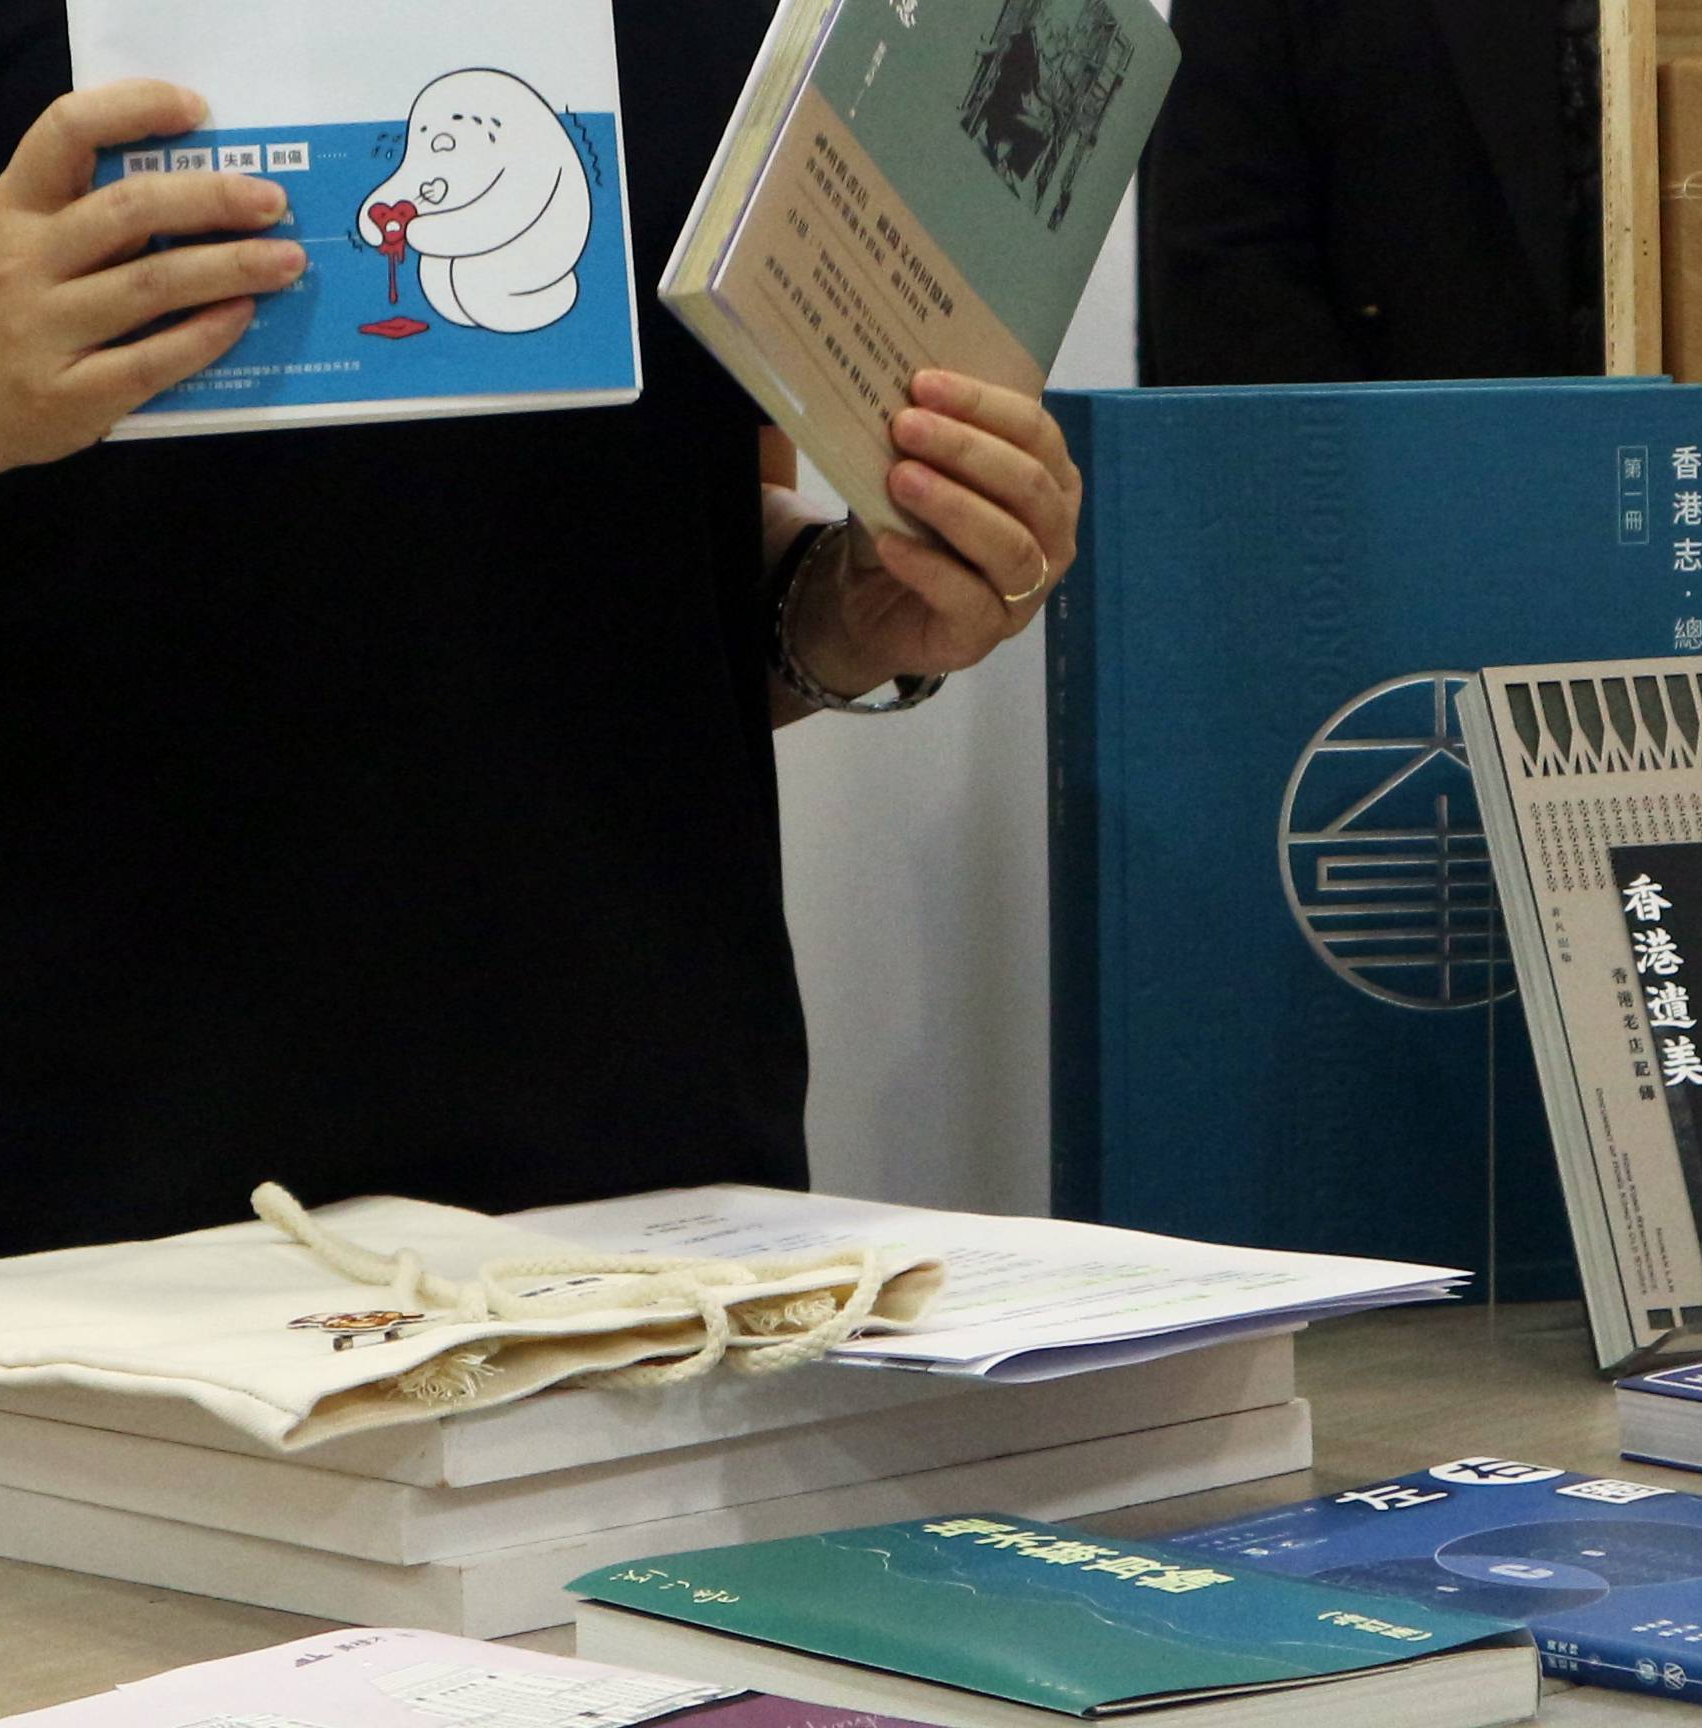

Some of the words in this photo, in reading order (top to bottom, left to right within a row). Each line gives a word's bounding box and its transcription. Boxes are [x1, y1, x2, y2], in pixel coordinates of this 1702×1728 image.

[176, 154, 206, 170] 分手
[223, 152, 254, 169] 失業
[272, 149, 303, 166] 創傷
[1623, 456, 1644, 533] 第一冊
